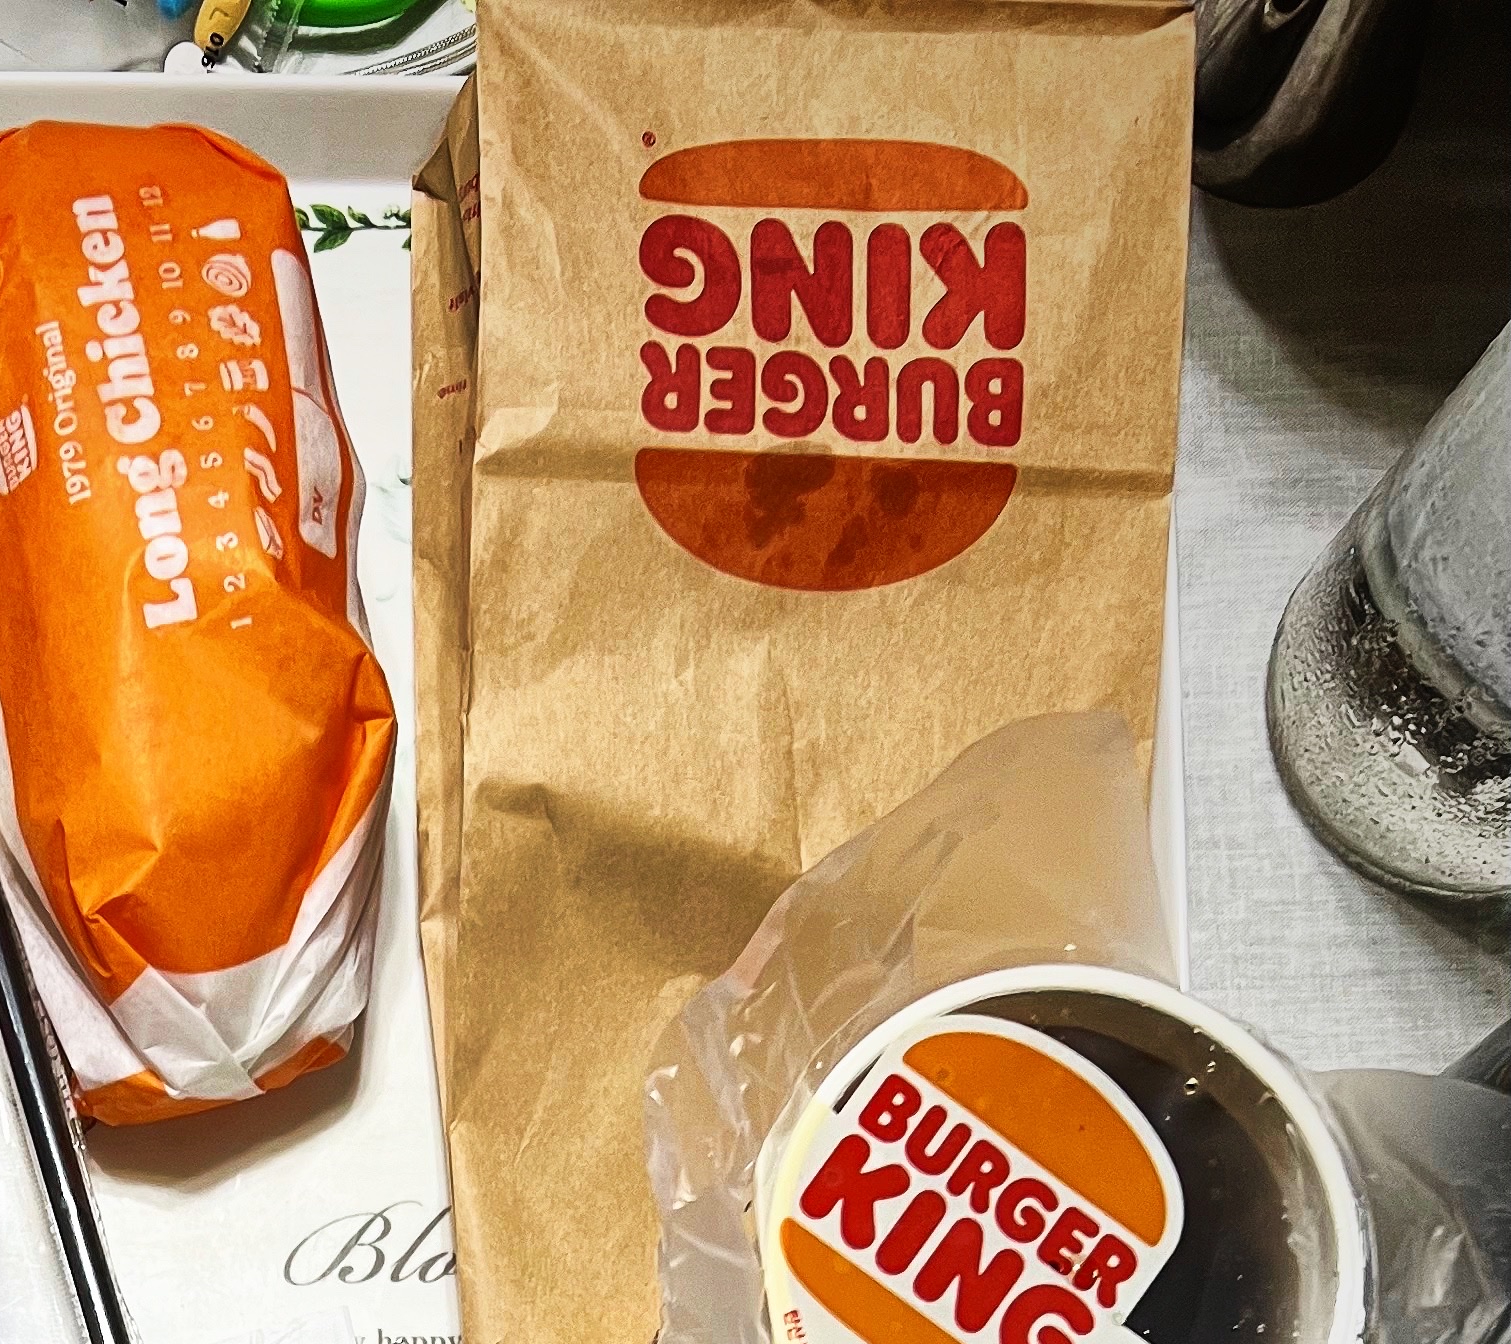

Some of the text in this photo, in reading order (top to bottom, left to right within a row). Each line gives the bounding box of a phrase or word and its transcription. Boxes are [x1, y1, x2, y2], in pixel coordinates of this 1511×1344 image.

[638, 214, 1027, 350] KING
[6, 410, 32, 480] KING
[35, 320, 92, 505] 1979 Original
[72, 194, 199, 629] Long Chicken
[139, 185, 252, 630] 1 2 3 4 5 6 7 8 9 10 11 12
[640, 340, 1025, 448] BURGER
[857, 1073, 1138, 1309] BURGER
